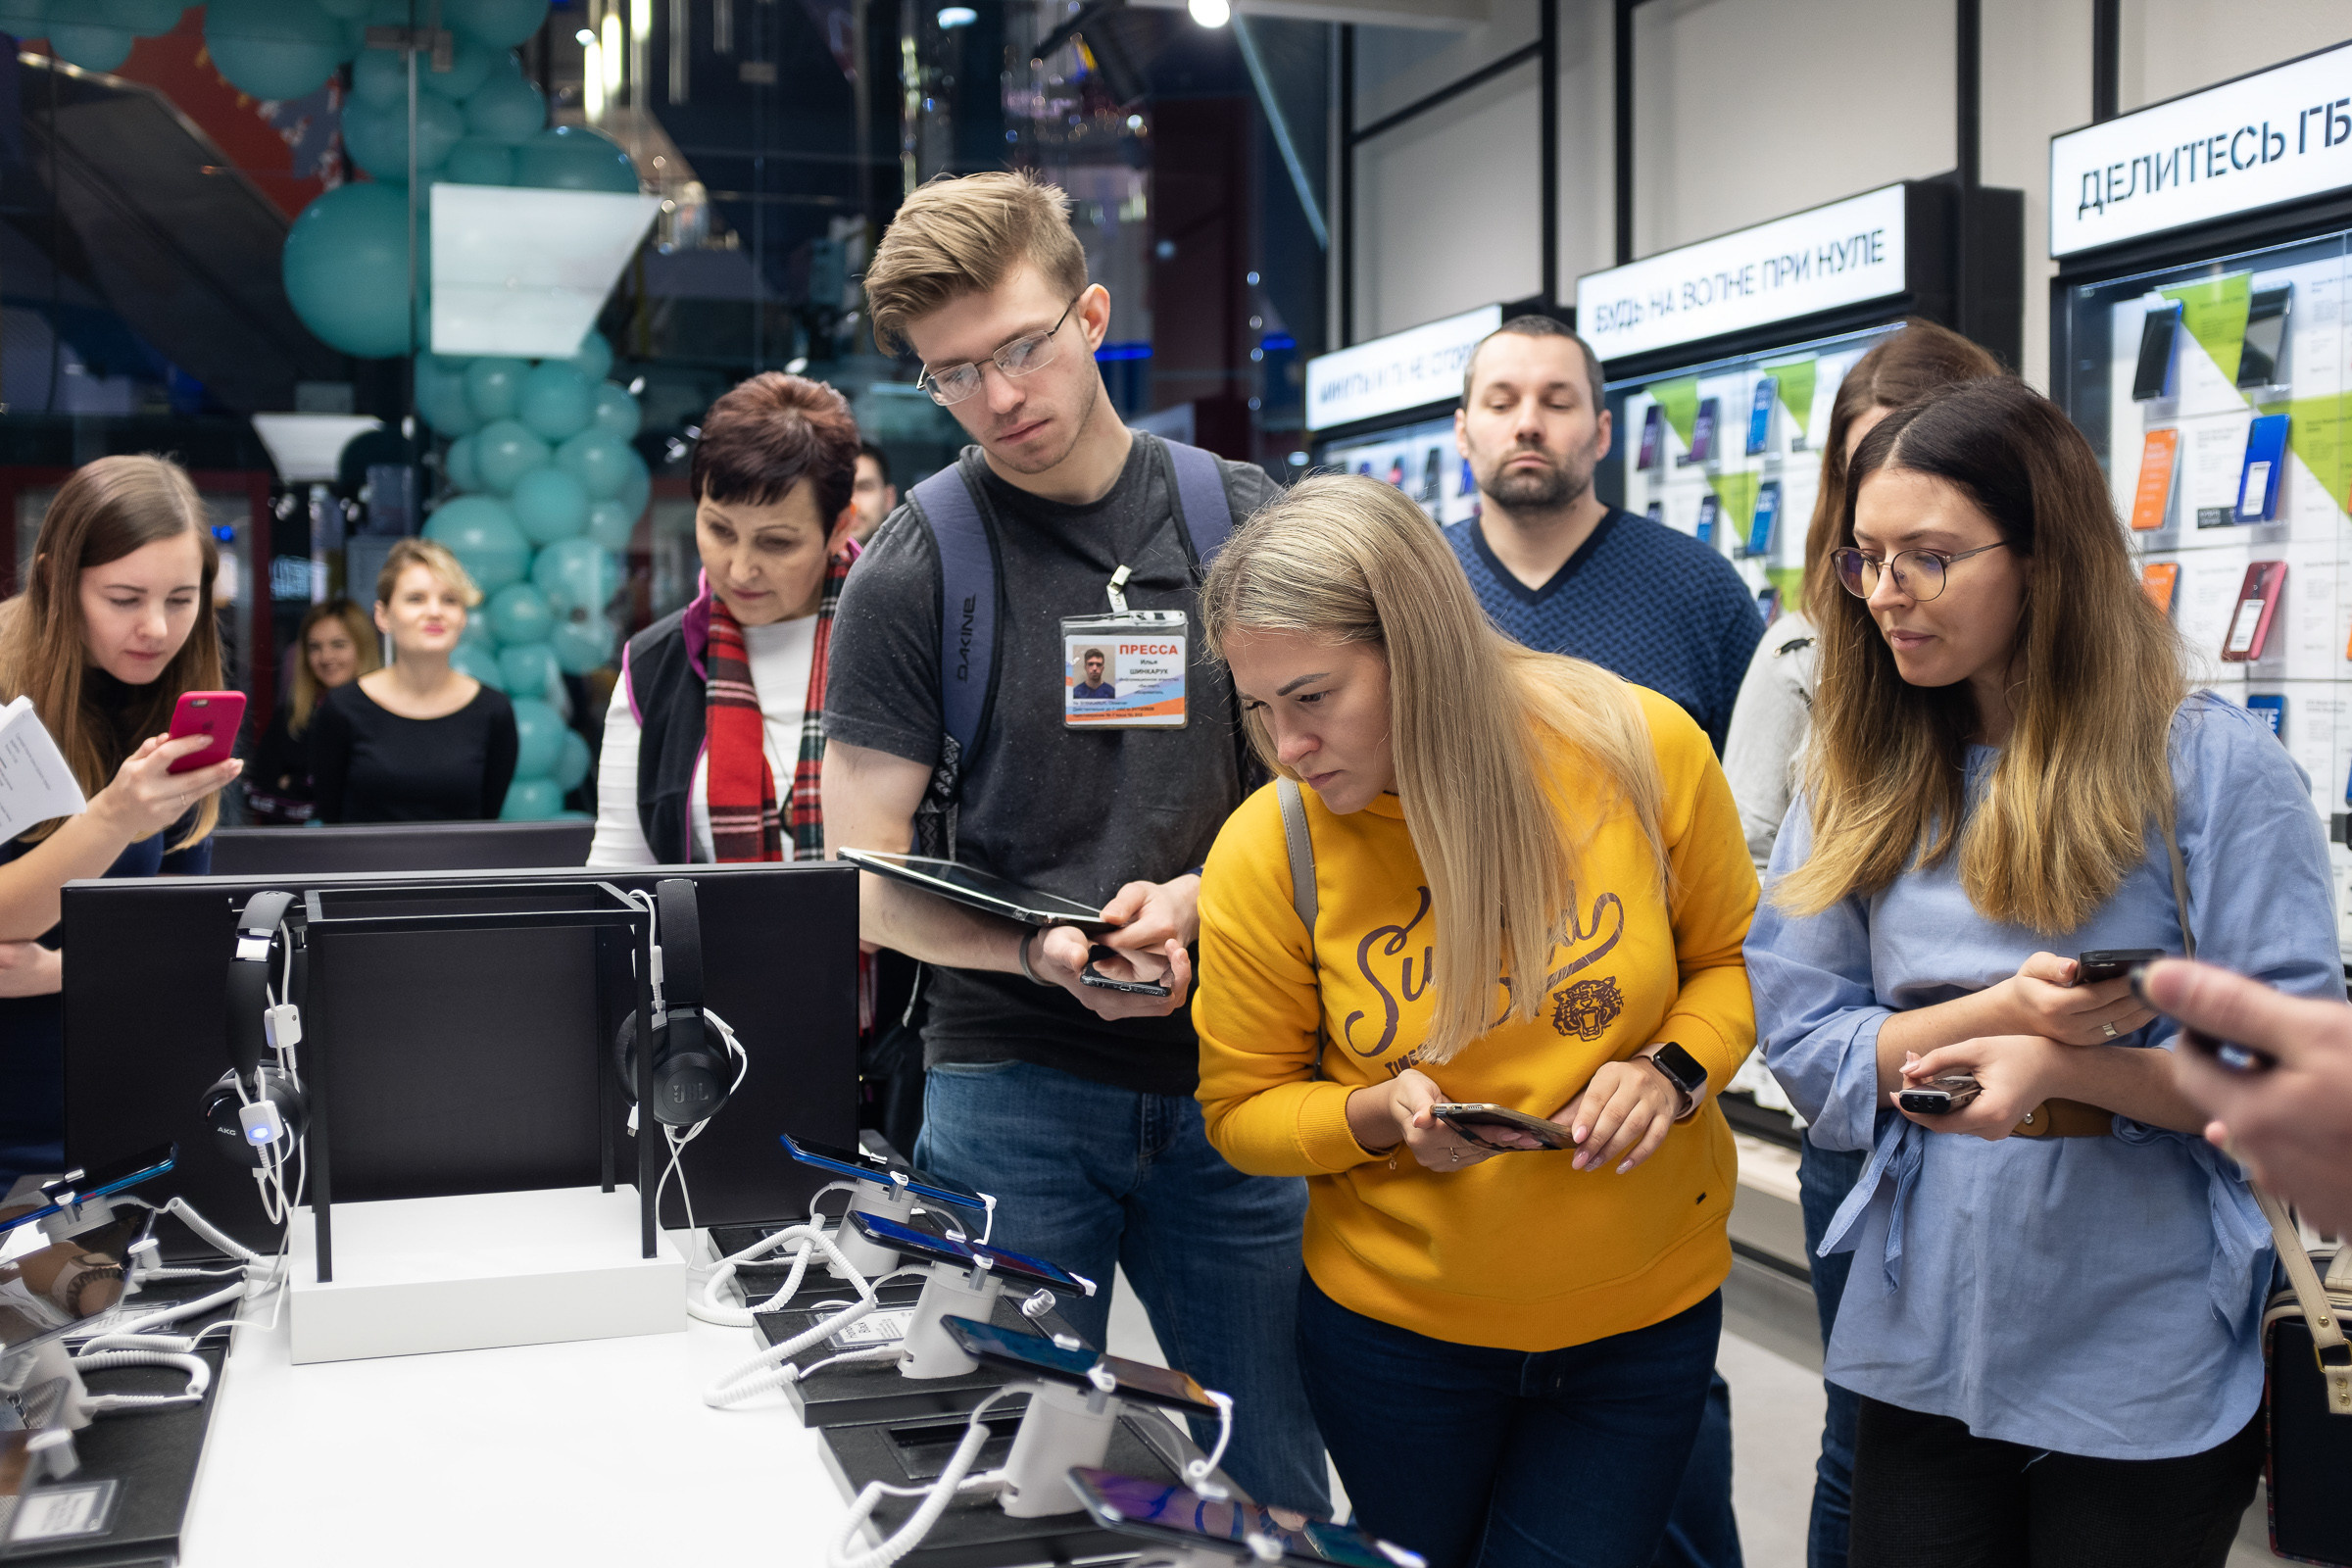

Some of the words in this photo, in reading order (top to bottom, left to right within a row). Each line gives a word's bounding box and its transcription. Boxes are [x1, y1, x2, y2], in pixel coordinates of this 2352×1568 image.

[2078, 121, 2286, 220] ДЕЛИТЕСЬ
[2298, 97, 2352, 155] ГБ
[1594, 297, 1643, 334] БУДЬ
[1649, 287, 1675, 317] НА
[1683, 265, 1755, 312] ВОЛНЕ
[1763, 248, 1811, 291] ПРИ
[1818, 228, 1884, 276] НУЛЕ
[956, 593, 976, 684] DAKINE
[1119, 644, 1178, 655] ПРЕССА
[217, 1126, 236, 1136] AKG
